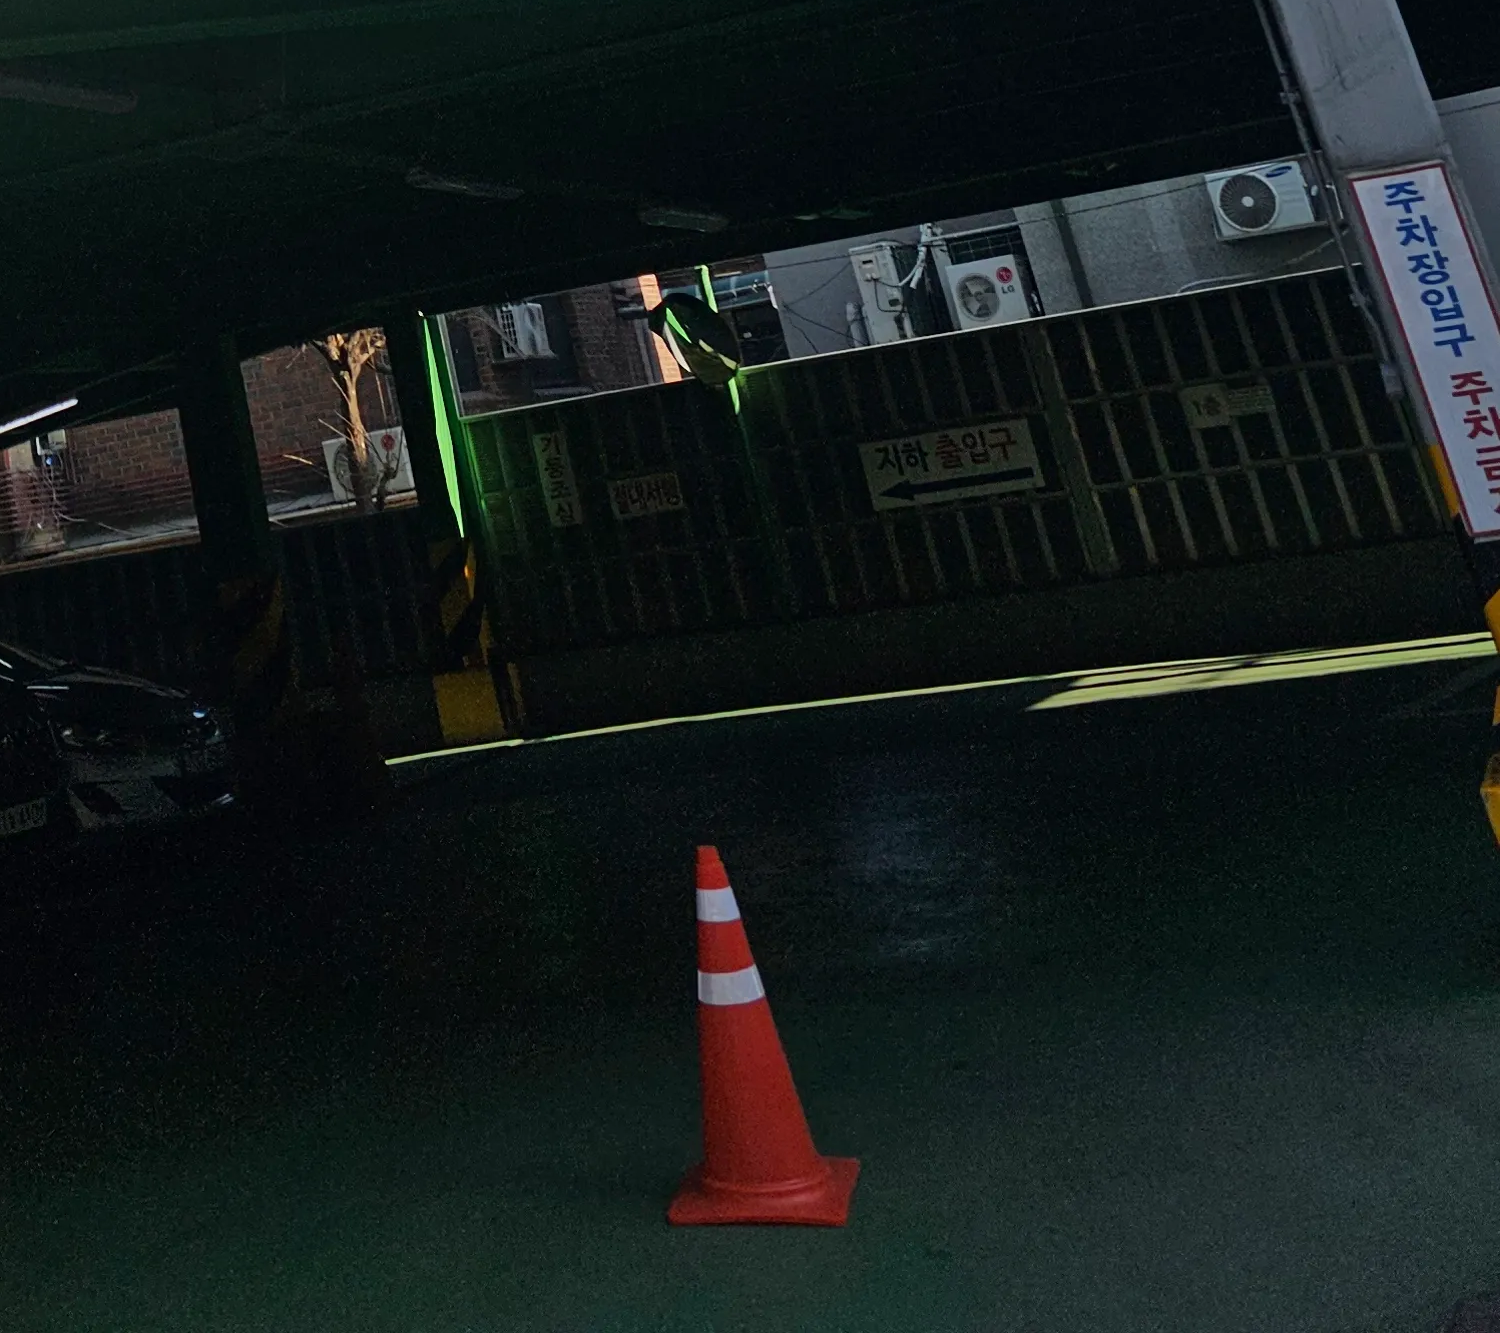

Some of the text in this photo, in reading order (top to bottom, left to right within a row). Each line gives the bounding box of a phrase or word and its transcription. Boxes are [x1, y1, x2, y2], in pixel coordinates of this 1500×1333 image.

[1001, 284, 1016, 295] LG
[1383, 180, 1500, 516] 주차장입구 주차금
[874, 427, 1017, 476] 지하 출입구
